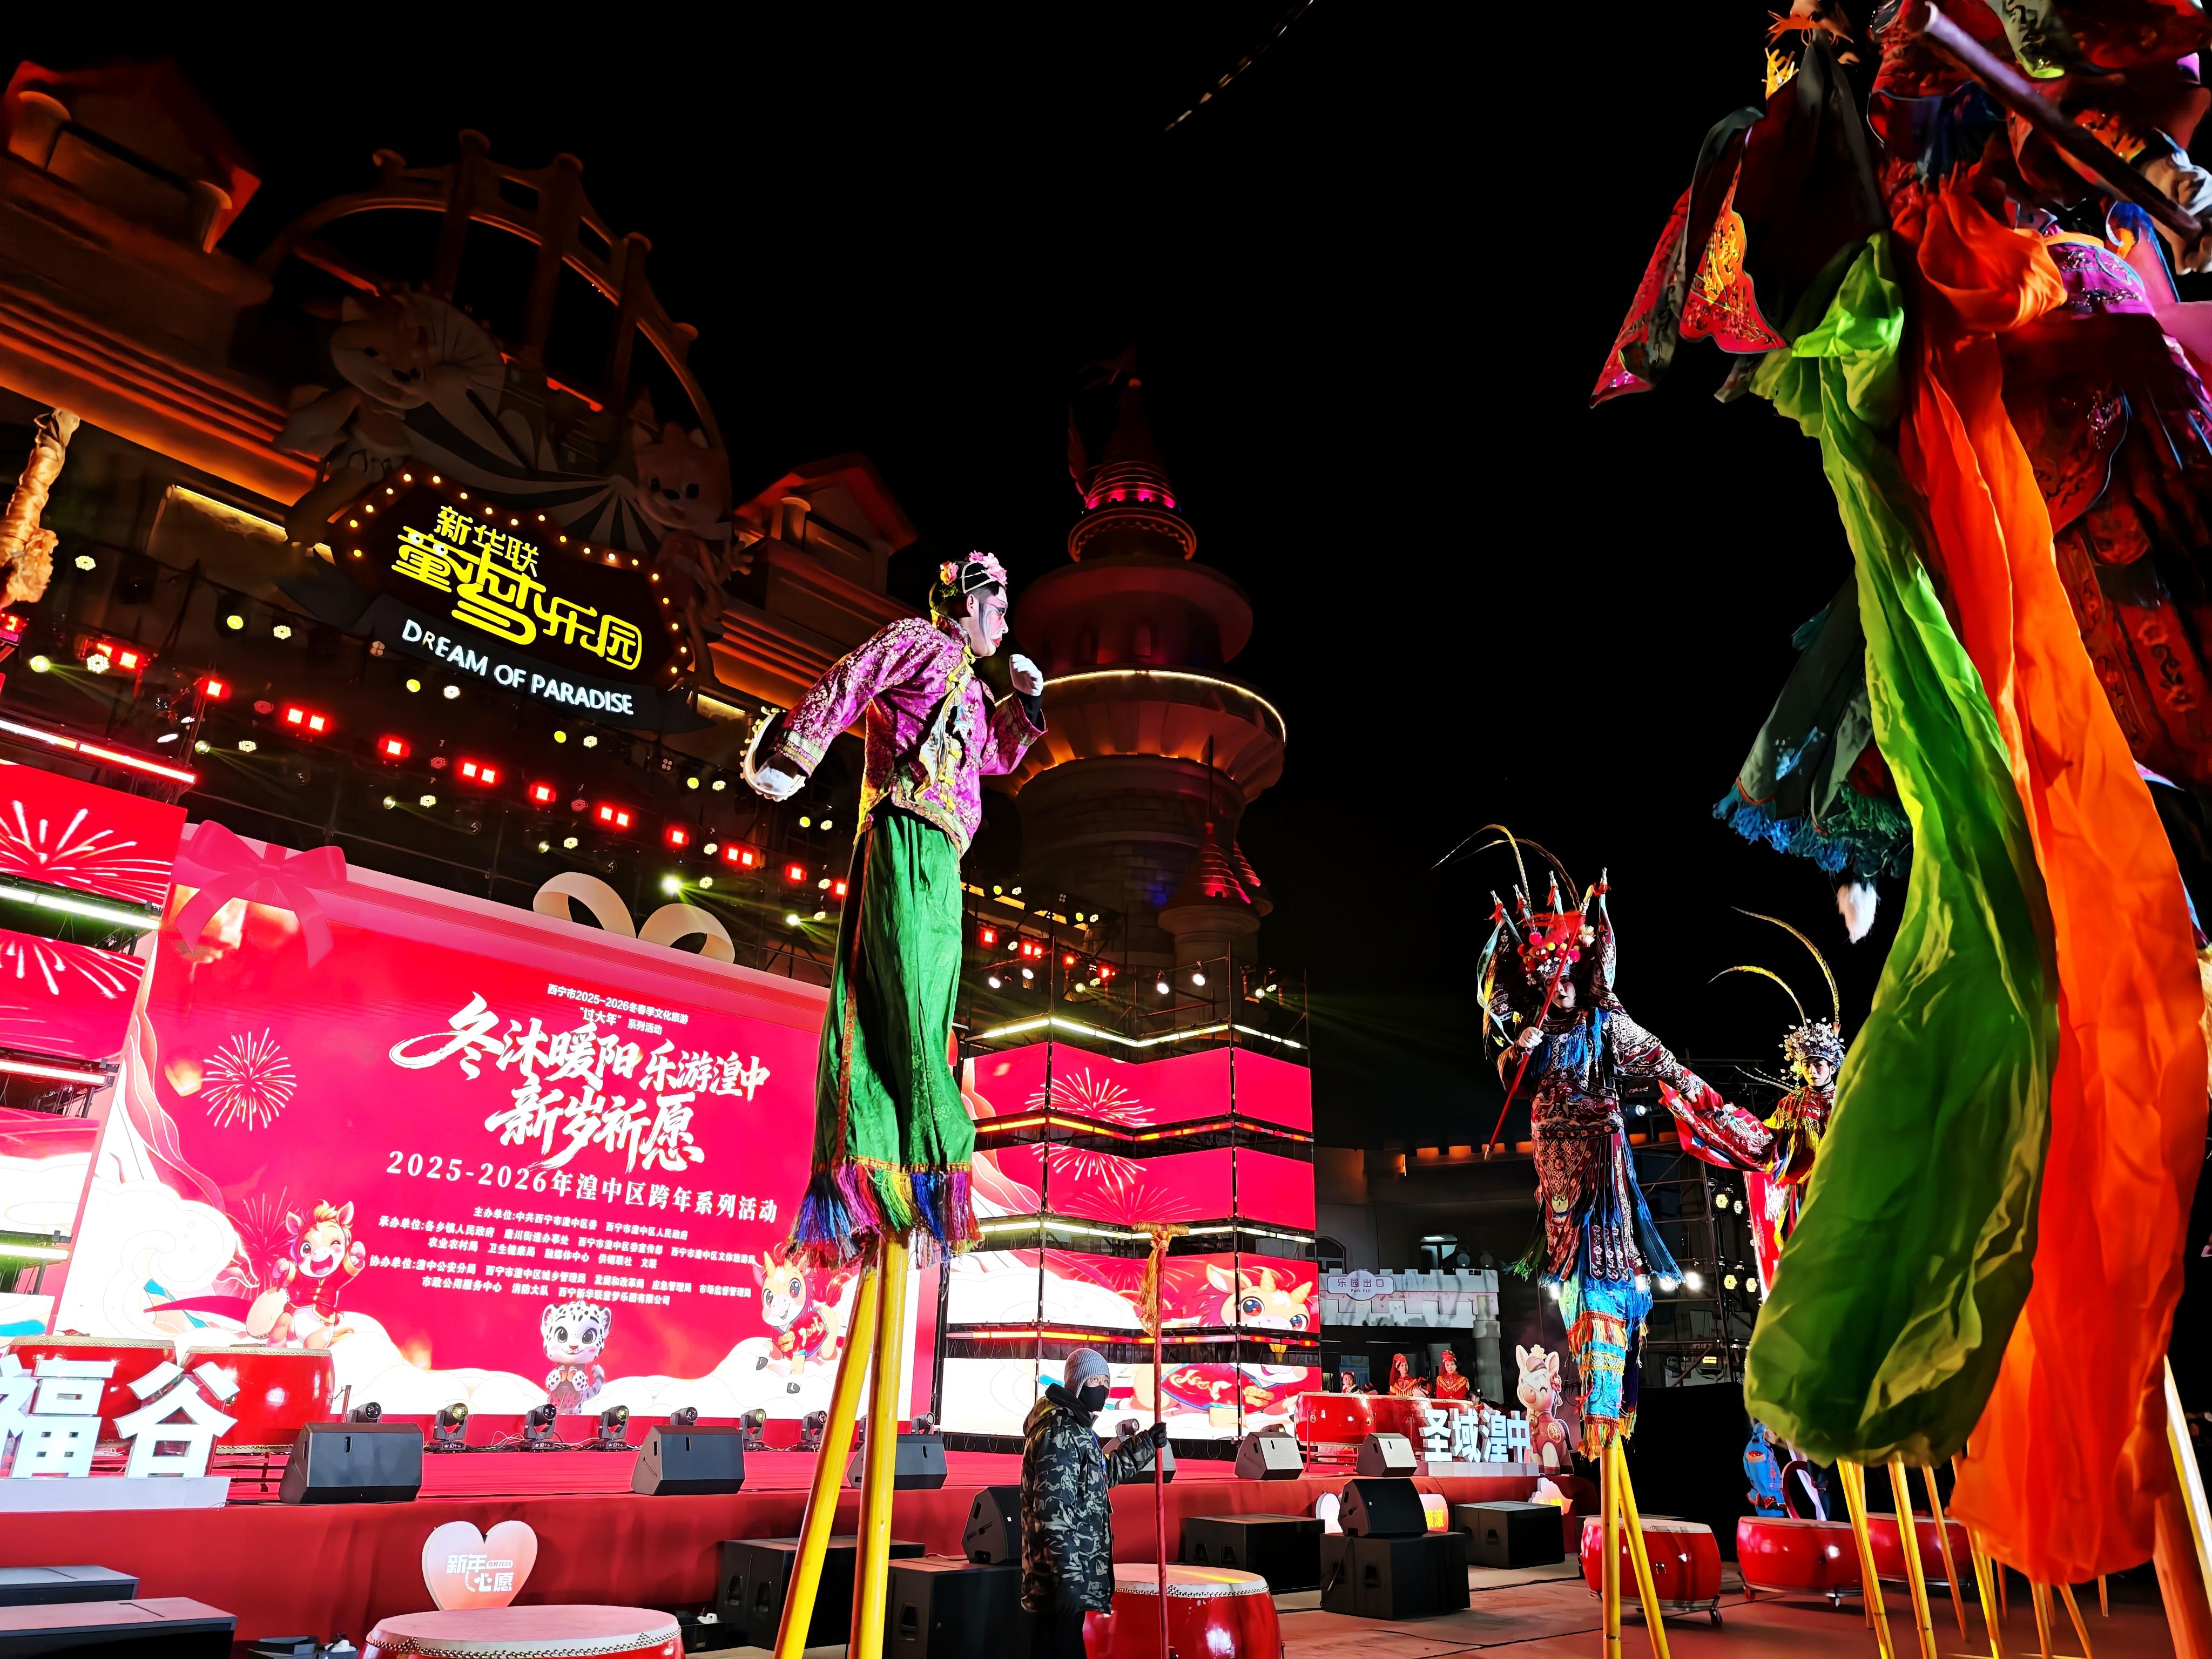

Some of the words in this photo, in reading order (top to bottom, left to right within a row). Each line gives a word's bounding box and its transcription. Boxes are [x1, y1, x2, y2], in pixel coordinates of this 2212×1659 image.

[434, 505, 539, 577] 新华联
[392, 526, 642, 670] 童梦乐园
[401, 619, 488, 676] DREAM
[494, 664, 527, 689] OF
[531, 673, 634, 715] PARADISE
[547, 983, 689, 1024] 西宁市2025-2026冬春季文化旅游
[627, 1018, 663, 1035] 系列活动
[484, 1077, 704, 1175] 新岁祈愿
[386, 1150, 778, 1224] 2025-2026年湟中区跨年系列活动
[428, 1237, 478, 1252] 农业农村局
[488, 1243, 536, 1258] 卫生健康局
[544, 1247, 590, 1262] 融媒体中心
[640, 1258, 657, 1269] 文联
[511, 1283, 549, 1296] 消防大队
[1338, 1278, 1384, 1287] 乐园出口
[1422, 1408, 1531, 1463] 圣域湟中
[446, 1554, 488, 1574] 新年
